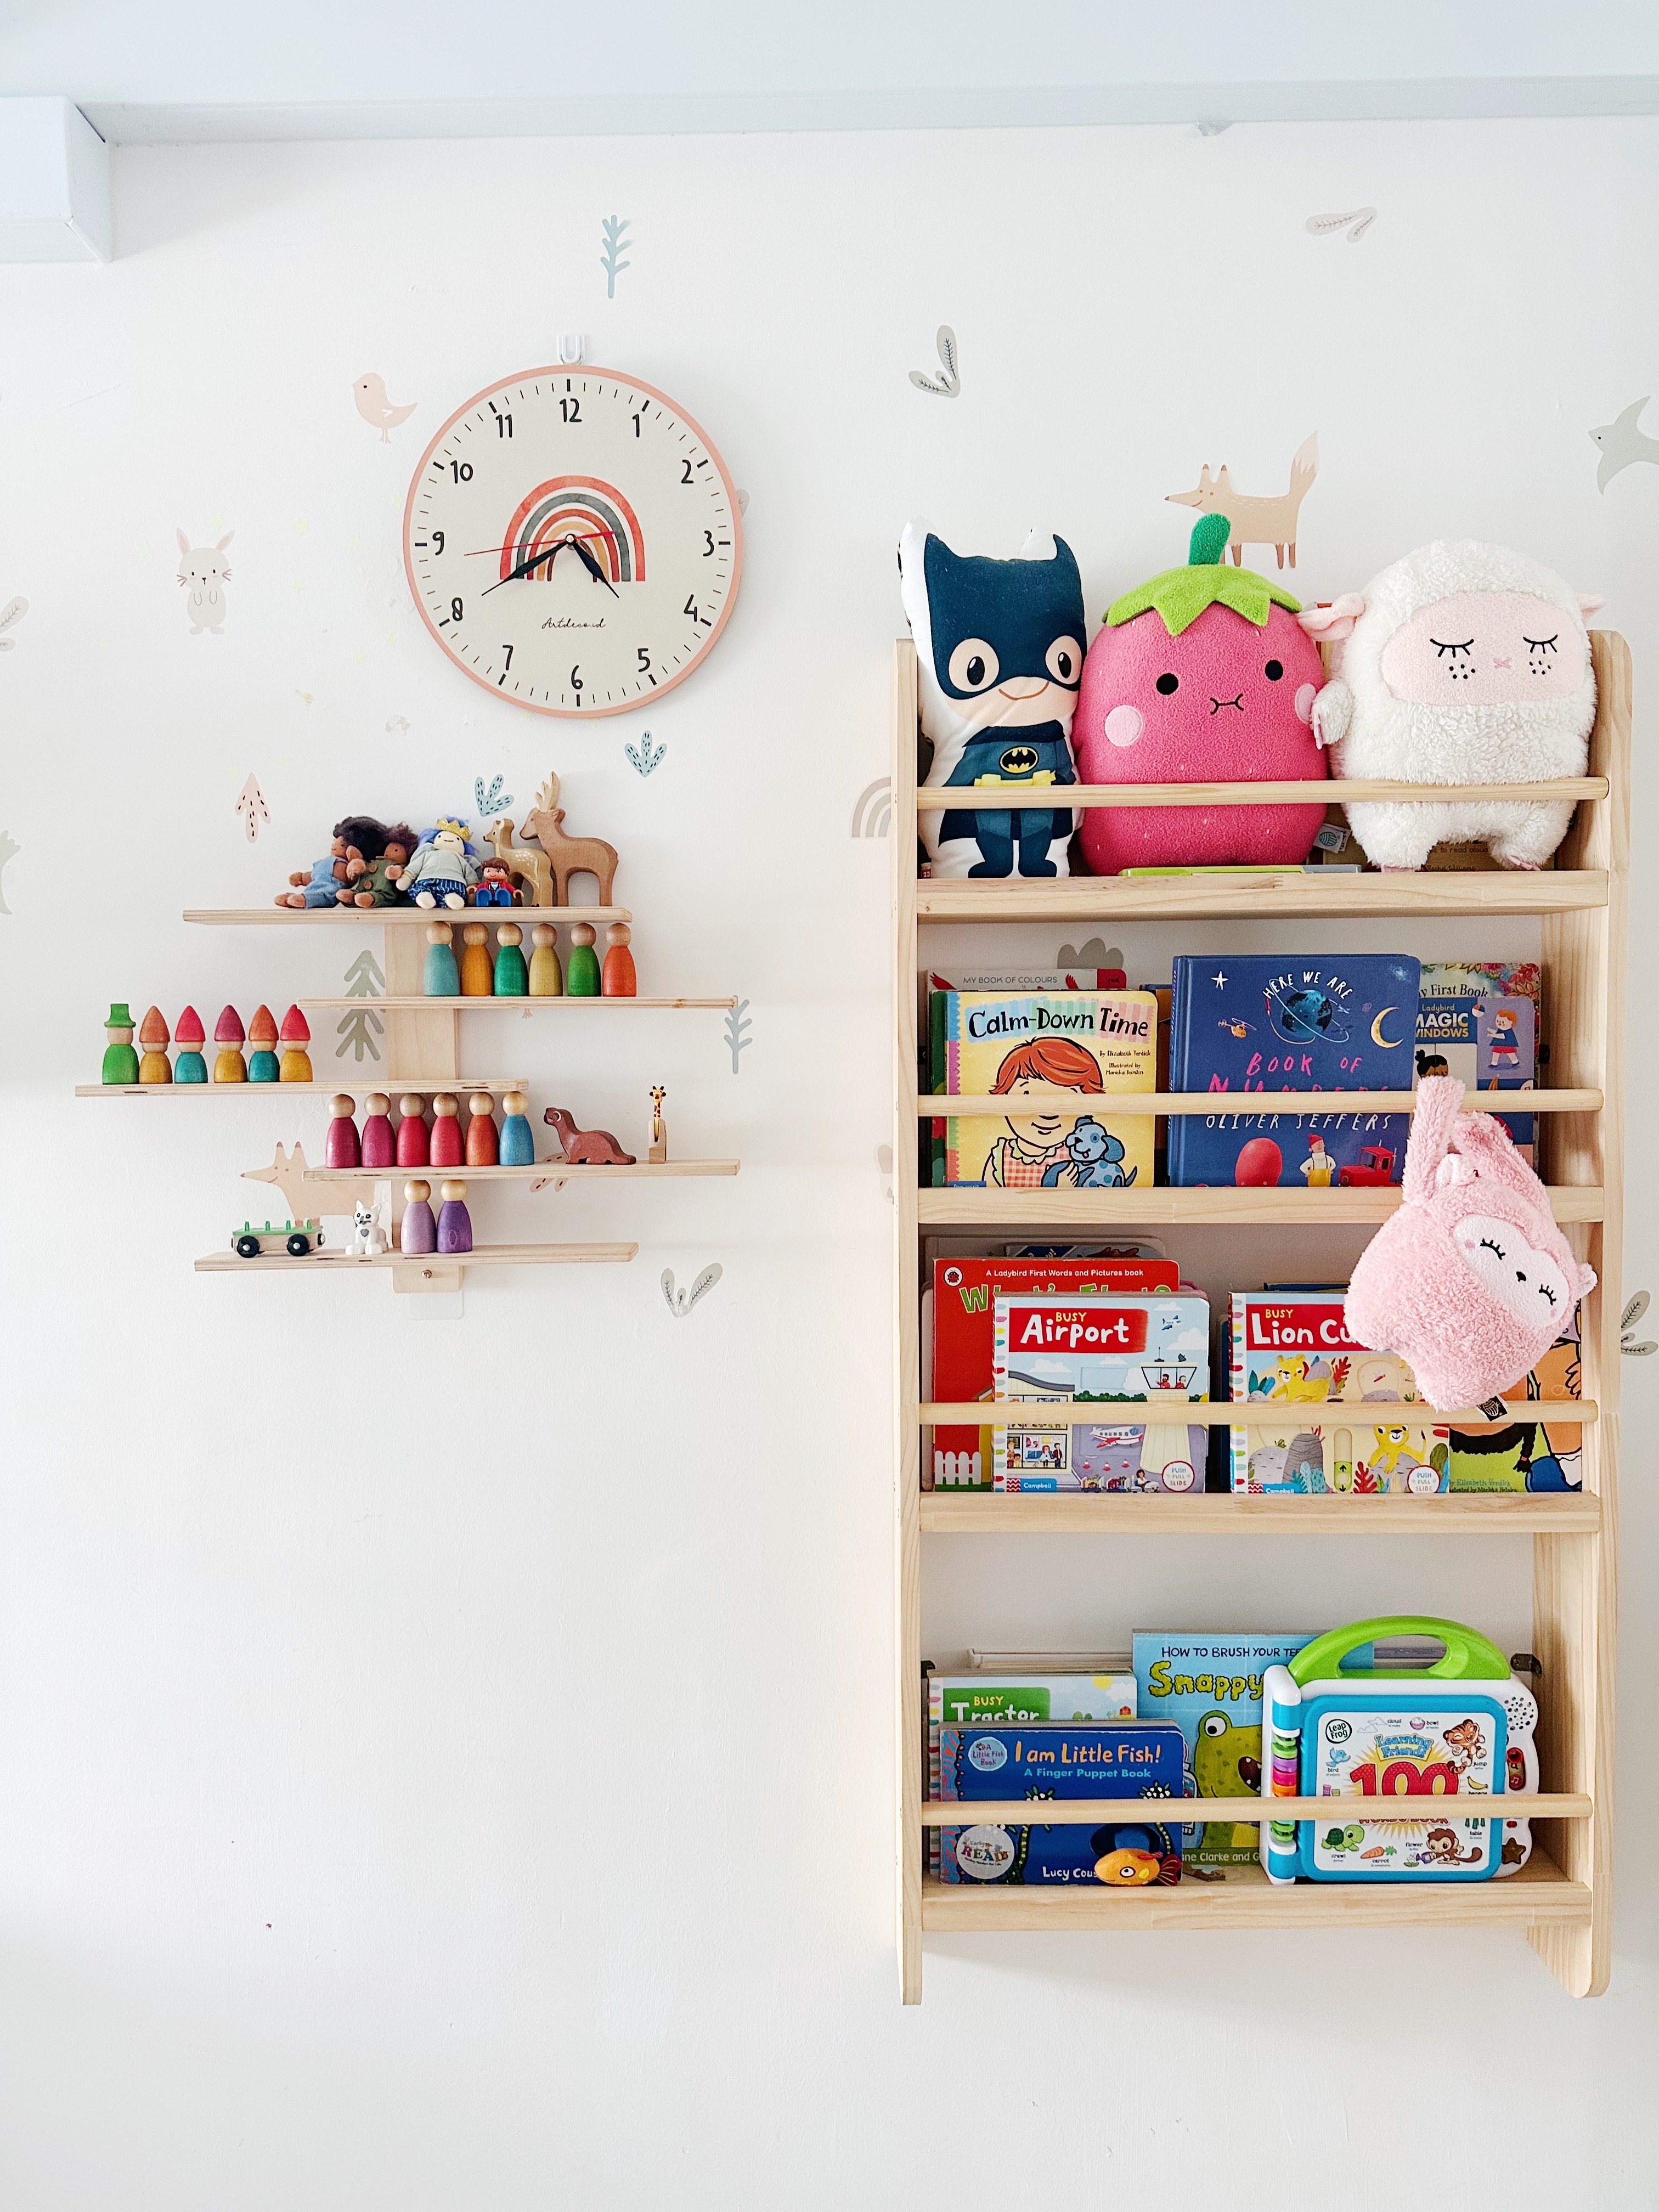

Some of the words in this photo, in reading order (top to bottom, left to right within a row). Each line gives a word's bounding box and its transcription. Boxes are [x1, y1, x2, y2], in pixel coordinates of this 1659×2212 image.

[559, 398, 582, 422] 12
[495, 414, 512, 438] 11
[632, 413, 641, 438] 1
[450, 460, 474, 483] 10
[680, 459, 694, 484] 2
[432, 531, 445, 555] 9
[703, 530, 714, 557] 3
[451, 597, 463, 621] 8
[684, 594, 698, 622] 4
[502, 645, 514, 670] 7
[637, 648, 651, 673] 5
[571, 665, 583, 690] 6
[1262, 974, 1294, 1000] HERE
[1302, 971, 1321, 984] WE
[1326, 977, 1353, 1000] ARE
[1419, 989, 1427, 997] y
[1430, 984, 1457, 996] First
[1459, 984, 1488, 997] Book
[1415, 1012, 1469, 1028] MAGIC
[1421, 1003, 1455, 1014] Ladybird
[968, 1007, 1094, 1038] Calm-Down
[1098, 1007, 1149, 1037] Time
[1245, 1052, 1313, 1076] BOOK
[1340, 1057, 1363, 1074] OF
[1206, 1114, 1280, 1130] OLIVER
[1295, 1114, 1392, 1131] JEFFERS
[994, 1269, 1028, 1278] Ladybird
[1125, 1268, 1144, 1277] book
[1056, 1312, 1087, 1322] BUSY
[1265, 1308, 1294, 1318] BUSY
[1020, 1314, 1130, 1348] Airport
[1251, 1313, 1314, 1345] Lion
[1319, 1319, 1357, 1344] Cu
[1161, 1646, 1190, 1657] HOW
[1193, 1647, 1208, 1657] TO
[1211, 1647, 1250, 1657] BRUSH
[1252, 1647, 1280, 1657] YOUR
[1283, 1647, 1302, 1657] TEE
[1148, 1660, 1264, 1701] Snappy
[950, 1702, 1040, 1722] Tractor
[973, 1696, 1005, 1706] BUSY
[1328, 1723, 1347, 1733] Leap
[1330, 1729, 1348, 1740] Frog
[1015, 1740, 1022, 1763] I
[1026, 1749, 1056, 1763] am
[1061, 1742, 1114, 1764] Little
[1117, 1743, 1161, 1764] Fish!
[1375, 1734, 1432, 1751] Learning
[1380, 1746, 1426, 1758] Friends
[972, 1750, 990, 1759] Little
[980, 1757, 997, 1766] Book
[1024, 1768, 1032, 1776] A
[1036, 1768, 1074, 1779] Finger
[1076, 1768, 1118, 1780] Puppet
[1121, 1768, 1152, 1778] Book
[1349, 1760, 1459, 1796] 100
[1200, 1852, 1229, 1861] Clarke
[1232, 1852, 1250, 1861] and
[1042, 1866, 1070, 1881] Lucy
[1073, 1867, 1098, 1878] Cous
